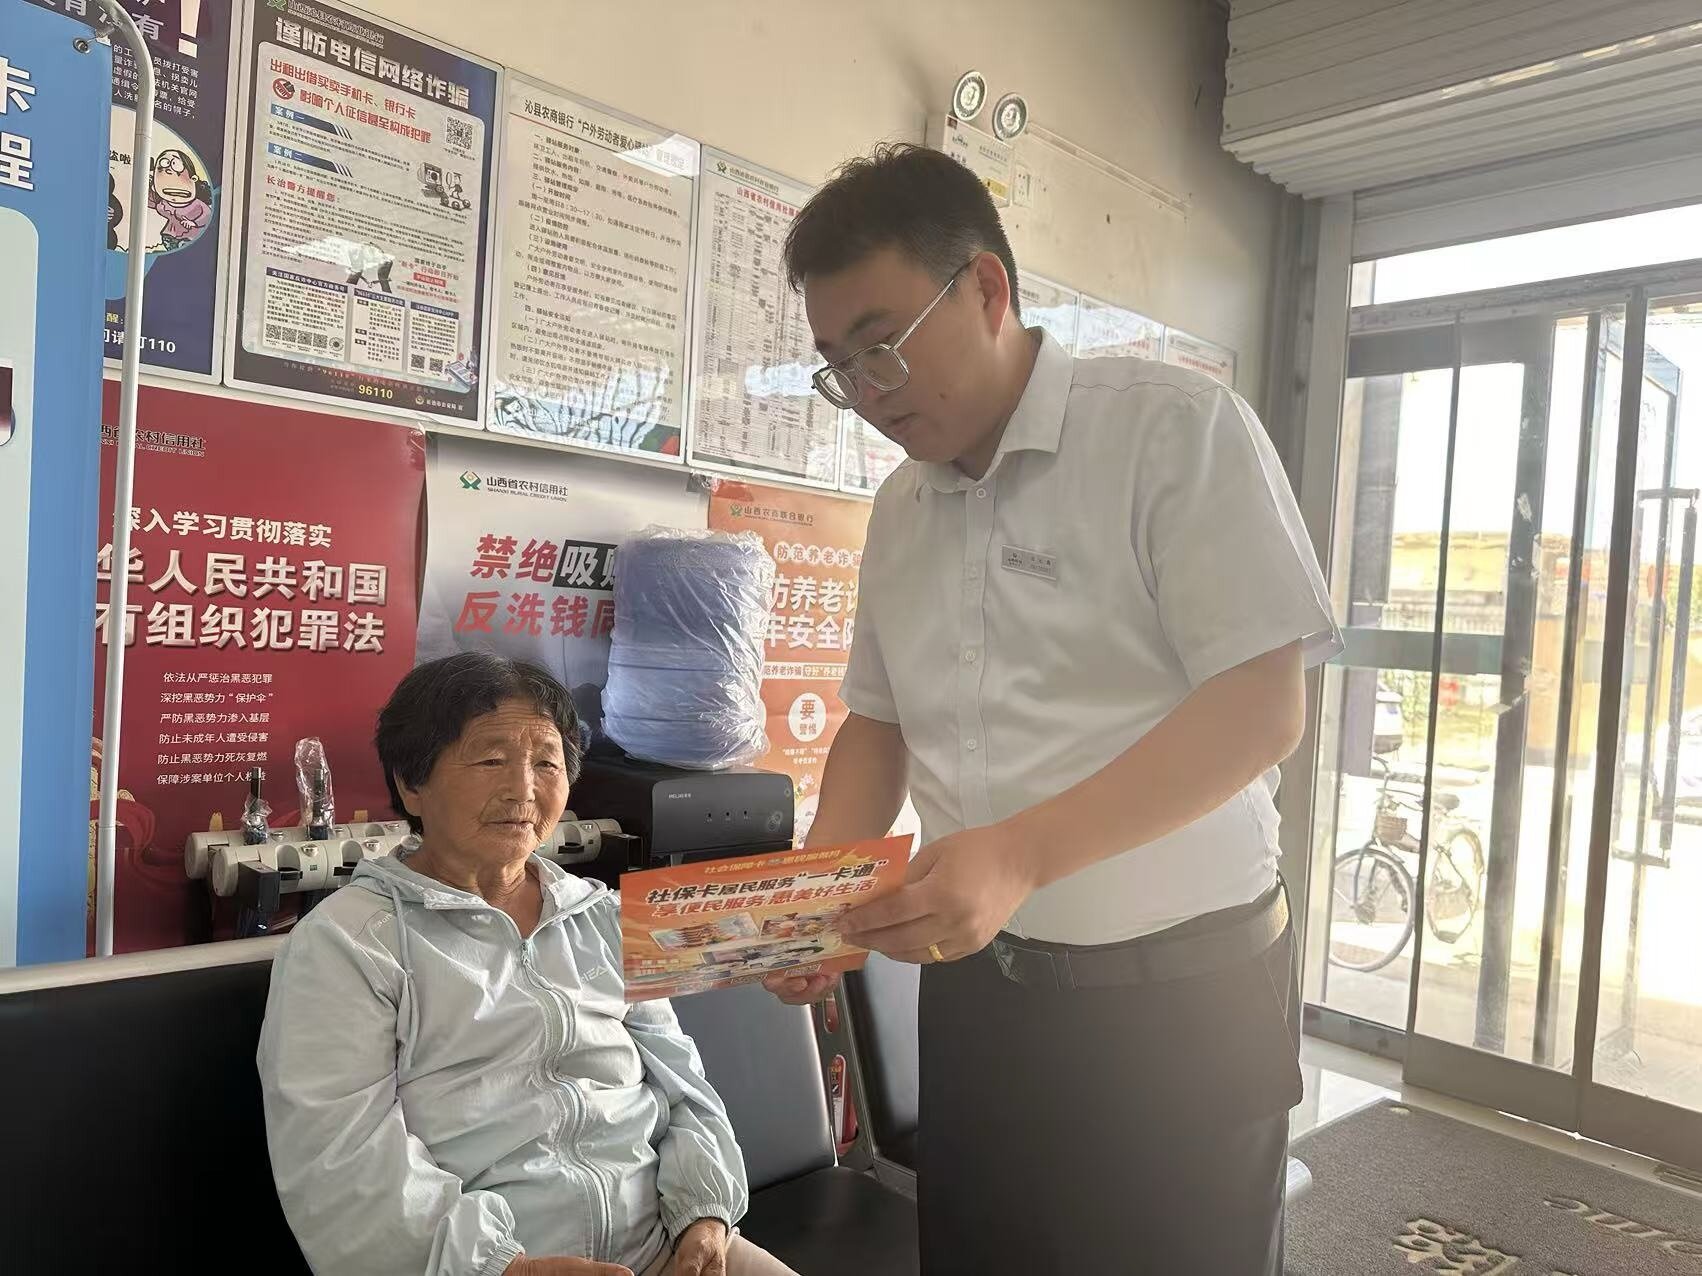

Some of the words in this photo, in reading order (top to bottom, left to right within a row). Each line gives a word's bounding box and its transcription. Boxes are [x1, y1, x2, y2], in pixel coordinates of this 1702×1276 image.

[275, 16, 470, 110] 谨防电信网络诈骗
[269, 58, 416, 120] 出租出借买卖手机卡、银行卡
[274, 105, 305, 120] 案例一
[299, 88, 433, 145] 影响个人征信甚至构成犯罪
[272, 144, 304, 162] 案例二
[358, 384, 394, 399] 96110
[486, 476, 568, 496] 山西省农村信用社
[112, 507, 332, 549] 深入学习贯彻落实
[163, 672, 273, 684] 依法从严惩治黑恶犯罪
[160, 692, 274, 704] 深挖黑恶势力“保护伞”
[160, 712, 270, 724] 严防黑恶势力渗入基层
[800, 699, 815, 720] 要
[159, 732, 269, 744] 防止未成年人遭受侵害
[157, 751, 269, 765] 防止黑恶势力死灰复燃
[647, 859, 889, 904] 社保卡居民服务“一卡通”
